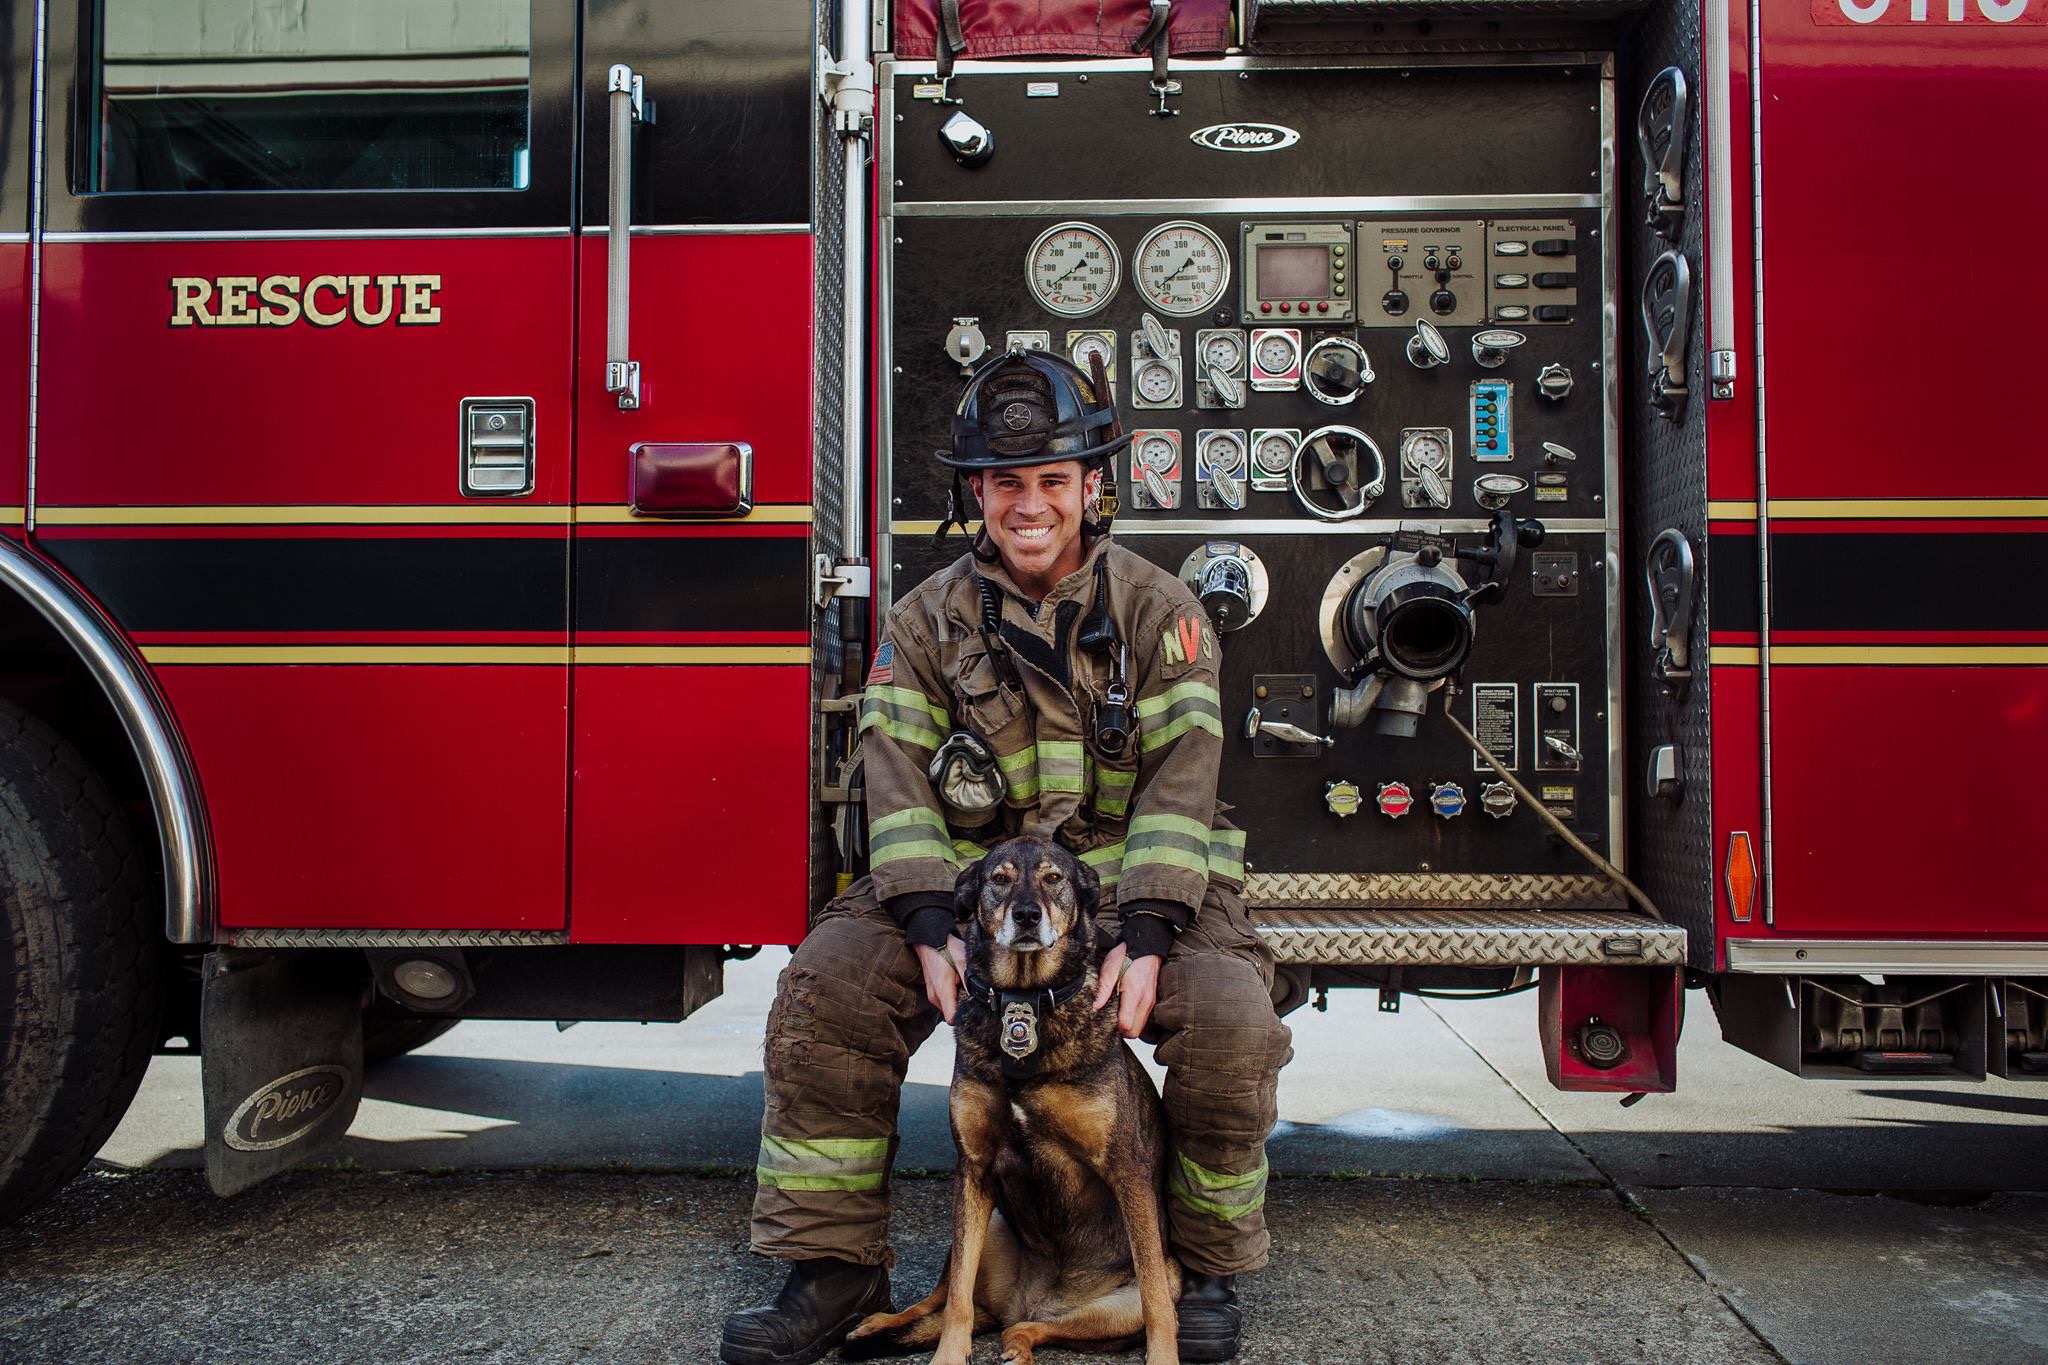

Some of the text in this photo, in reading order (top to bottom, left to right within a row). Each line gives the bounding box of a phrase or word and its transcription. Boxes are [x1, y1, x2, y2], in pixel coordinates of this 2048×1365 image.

[1214, 127, 1274, 147] Pierce
[1174, 240, 1188, 248] 300
[1198, 265, 1212, 273] 500
[169, 274, 441, 327] RESCUE
[1163, 616, 1212, 666] NVS
[251, 1082, 330, 1138] Pierce
